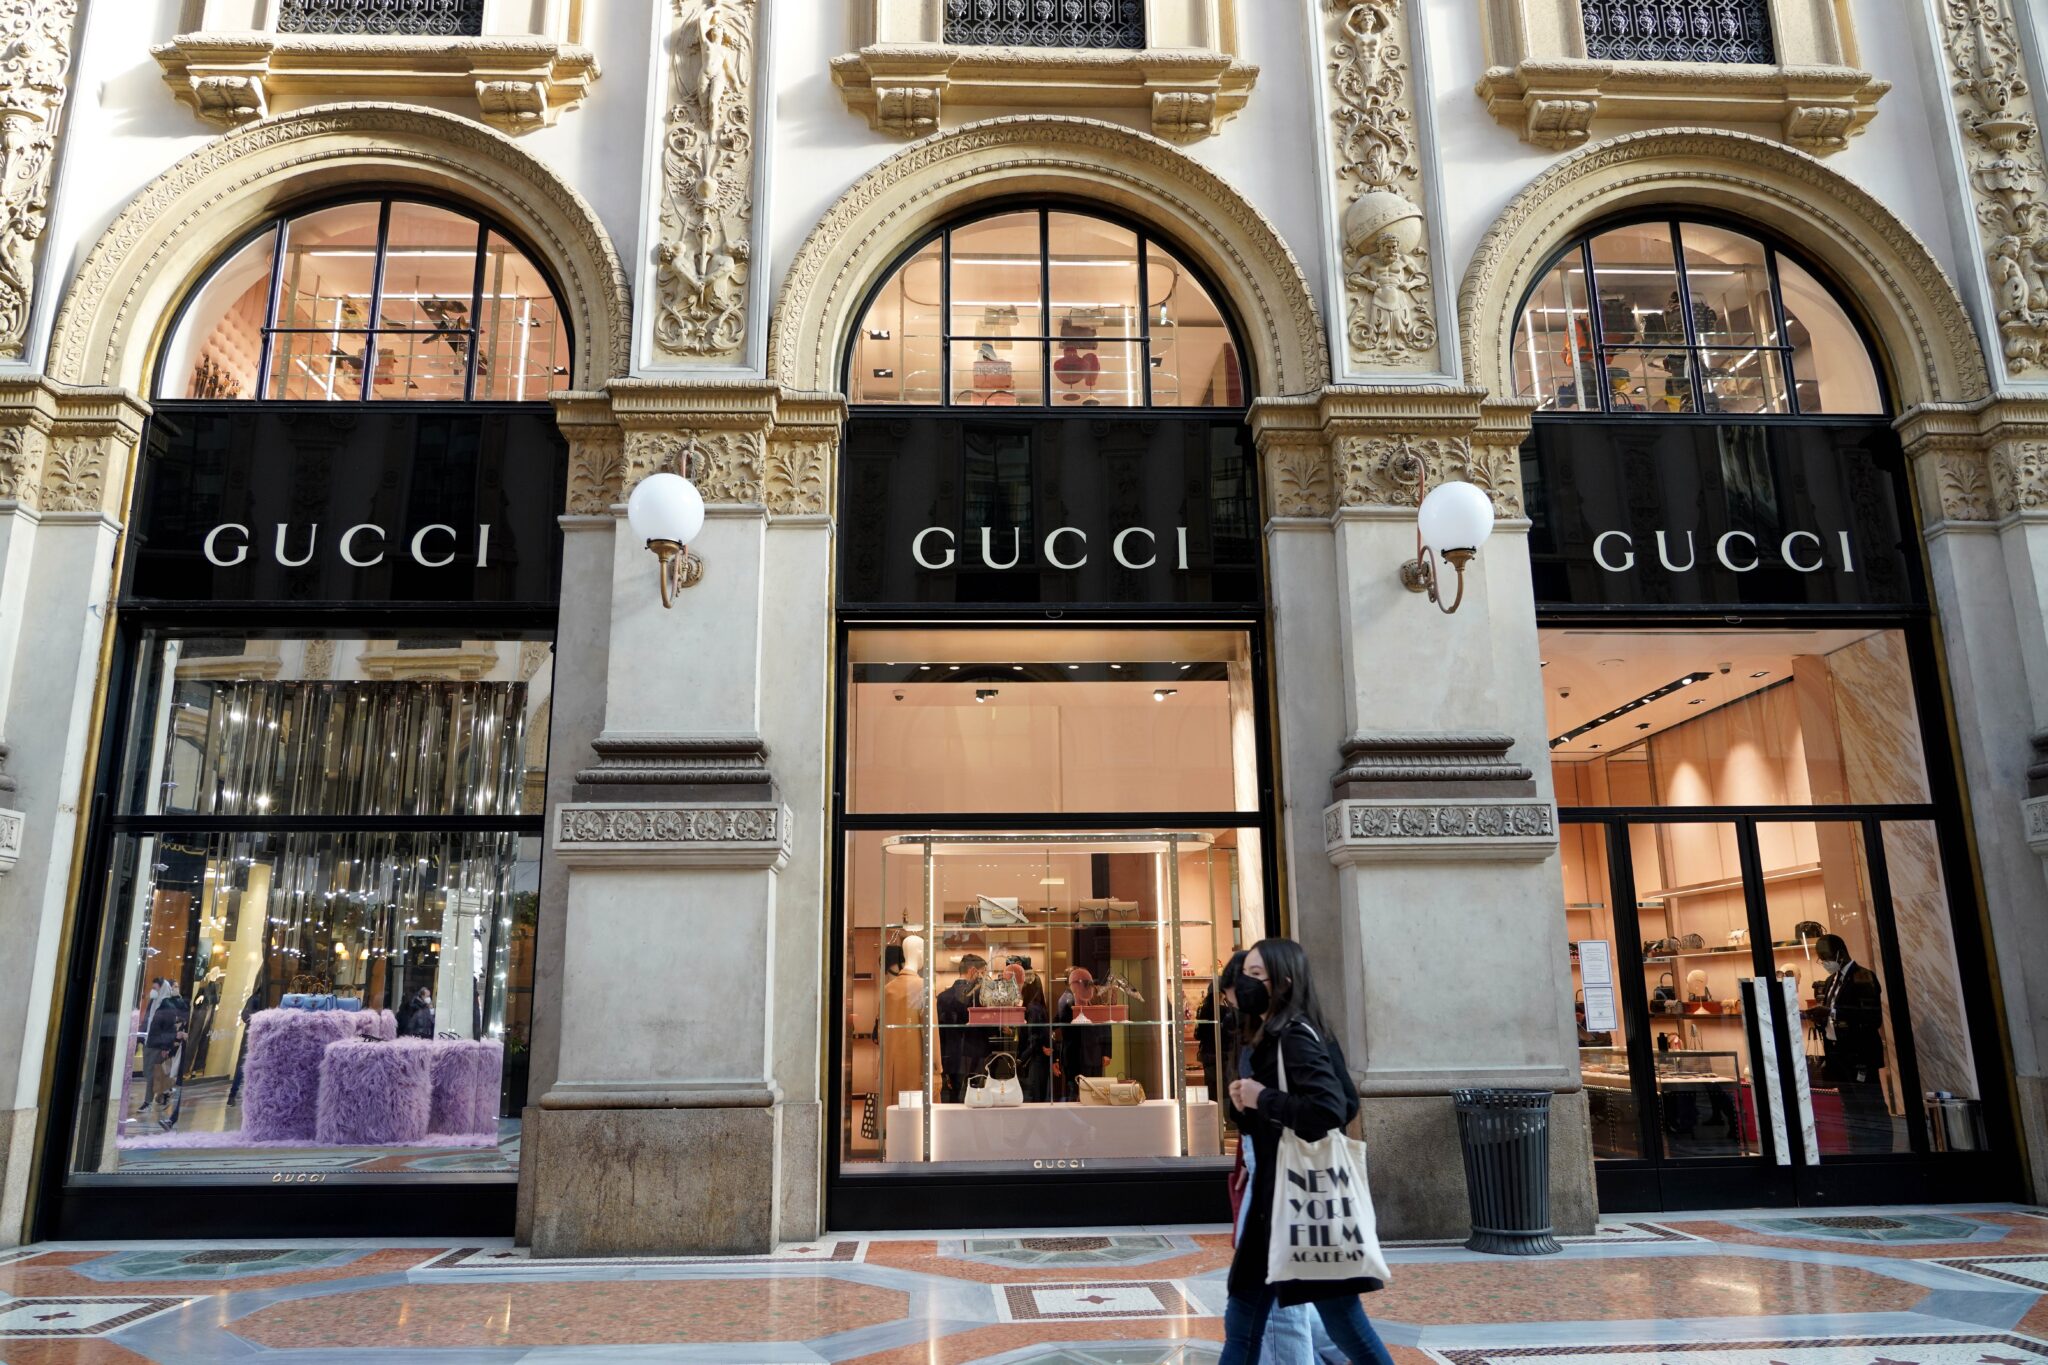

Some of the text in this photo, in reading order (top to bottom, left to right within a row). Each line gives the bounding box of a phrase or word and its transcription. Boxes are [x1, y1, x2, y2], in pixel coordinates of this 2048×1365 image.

[203, 523, 490, 567] GUCCI
[912, 526, 1189, 570] GUCCI
[1592, 530, 1855, 572] GUCCI
[1033, 1159, 1085, 1169] GUCCI
[272, 1172, 326, 1183] GUCCI
[1287, 1166, 1351, 1193] NEW
[1289, 1223, 1364, 1246] FILM
[1290, 1250, 1364, 1262] ACADEMY
